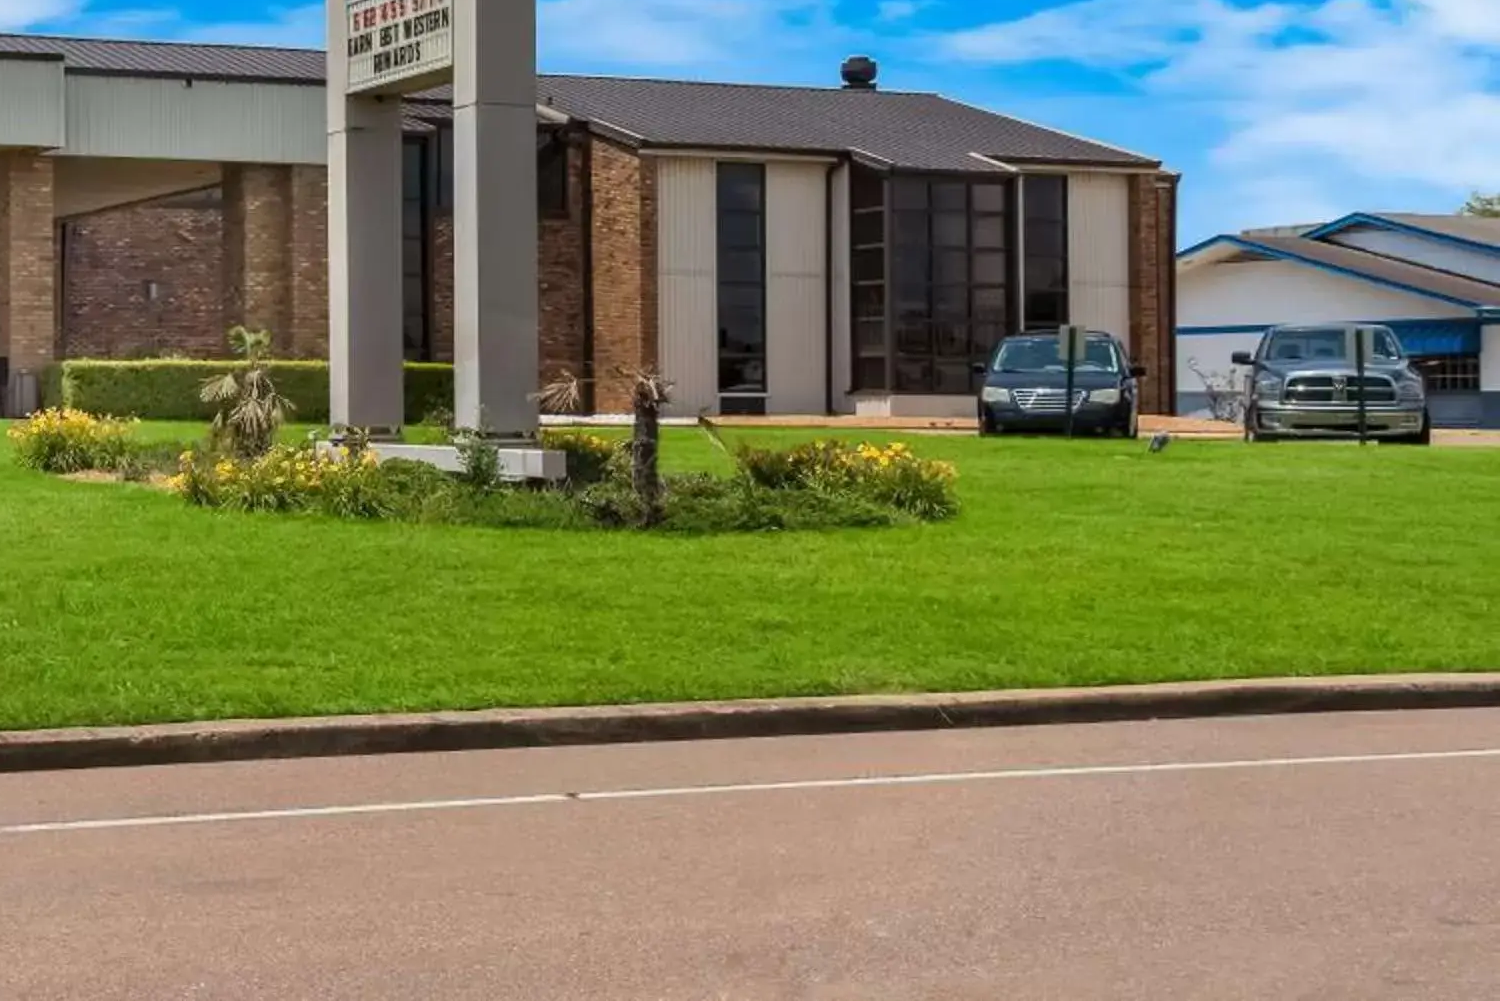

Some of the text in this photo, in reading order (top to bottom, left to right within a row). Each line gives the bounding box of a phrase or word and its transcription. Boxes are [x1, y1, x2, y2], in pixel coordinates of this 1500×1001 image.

[347, 7, 449, 57] EARN BEST WESTERN
[374, 41, 421, 74] REWARDS
